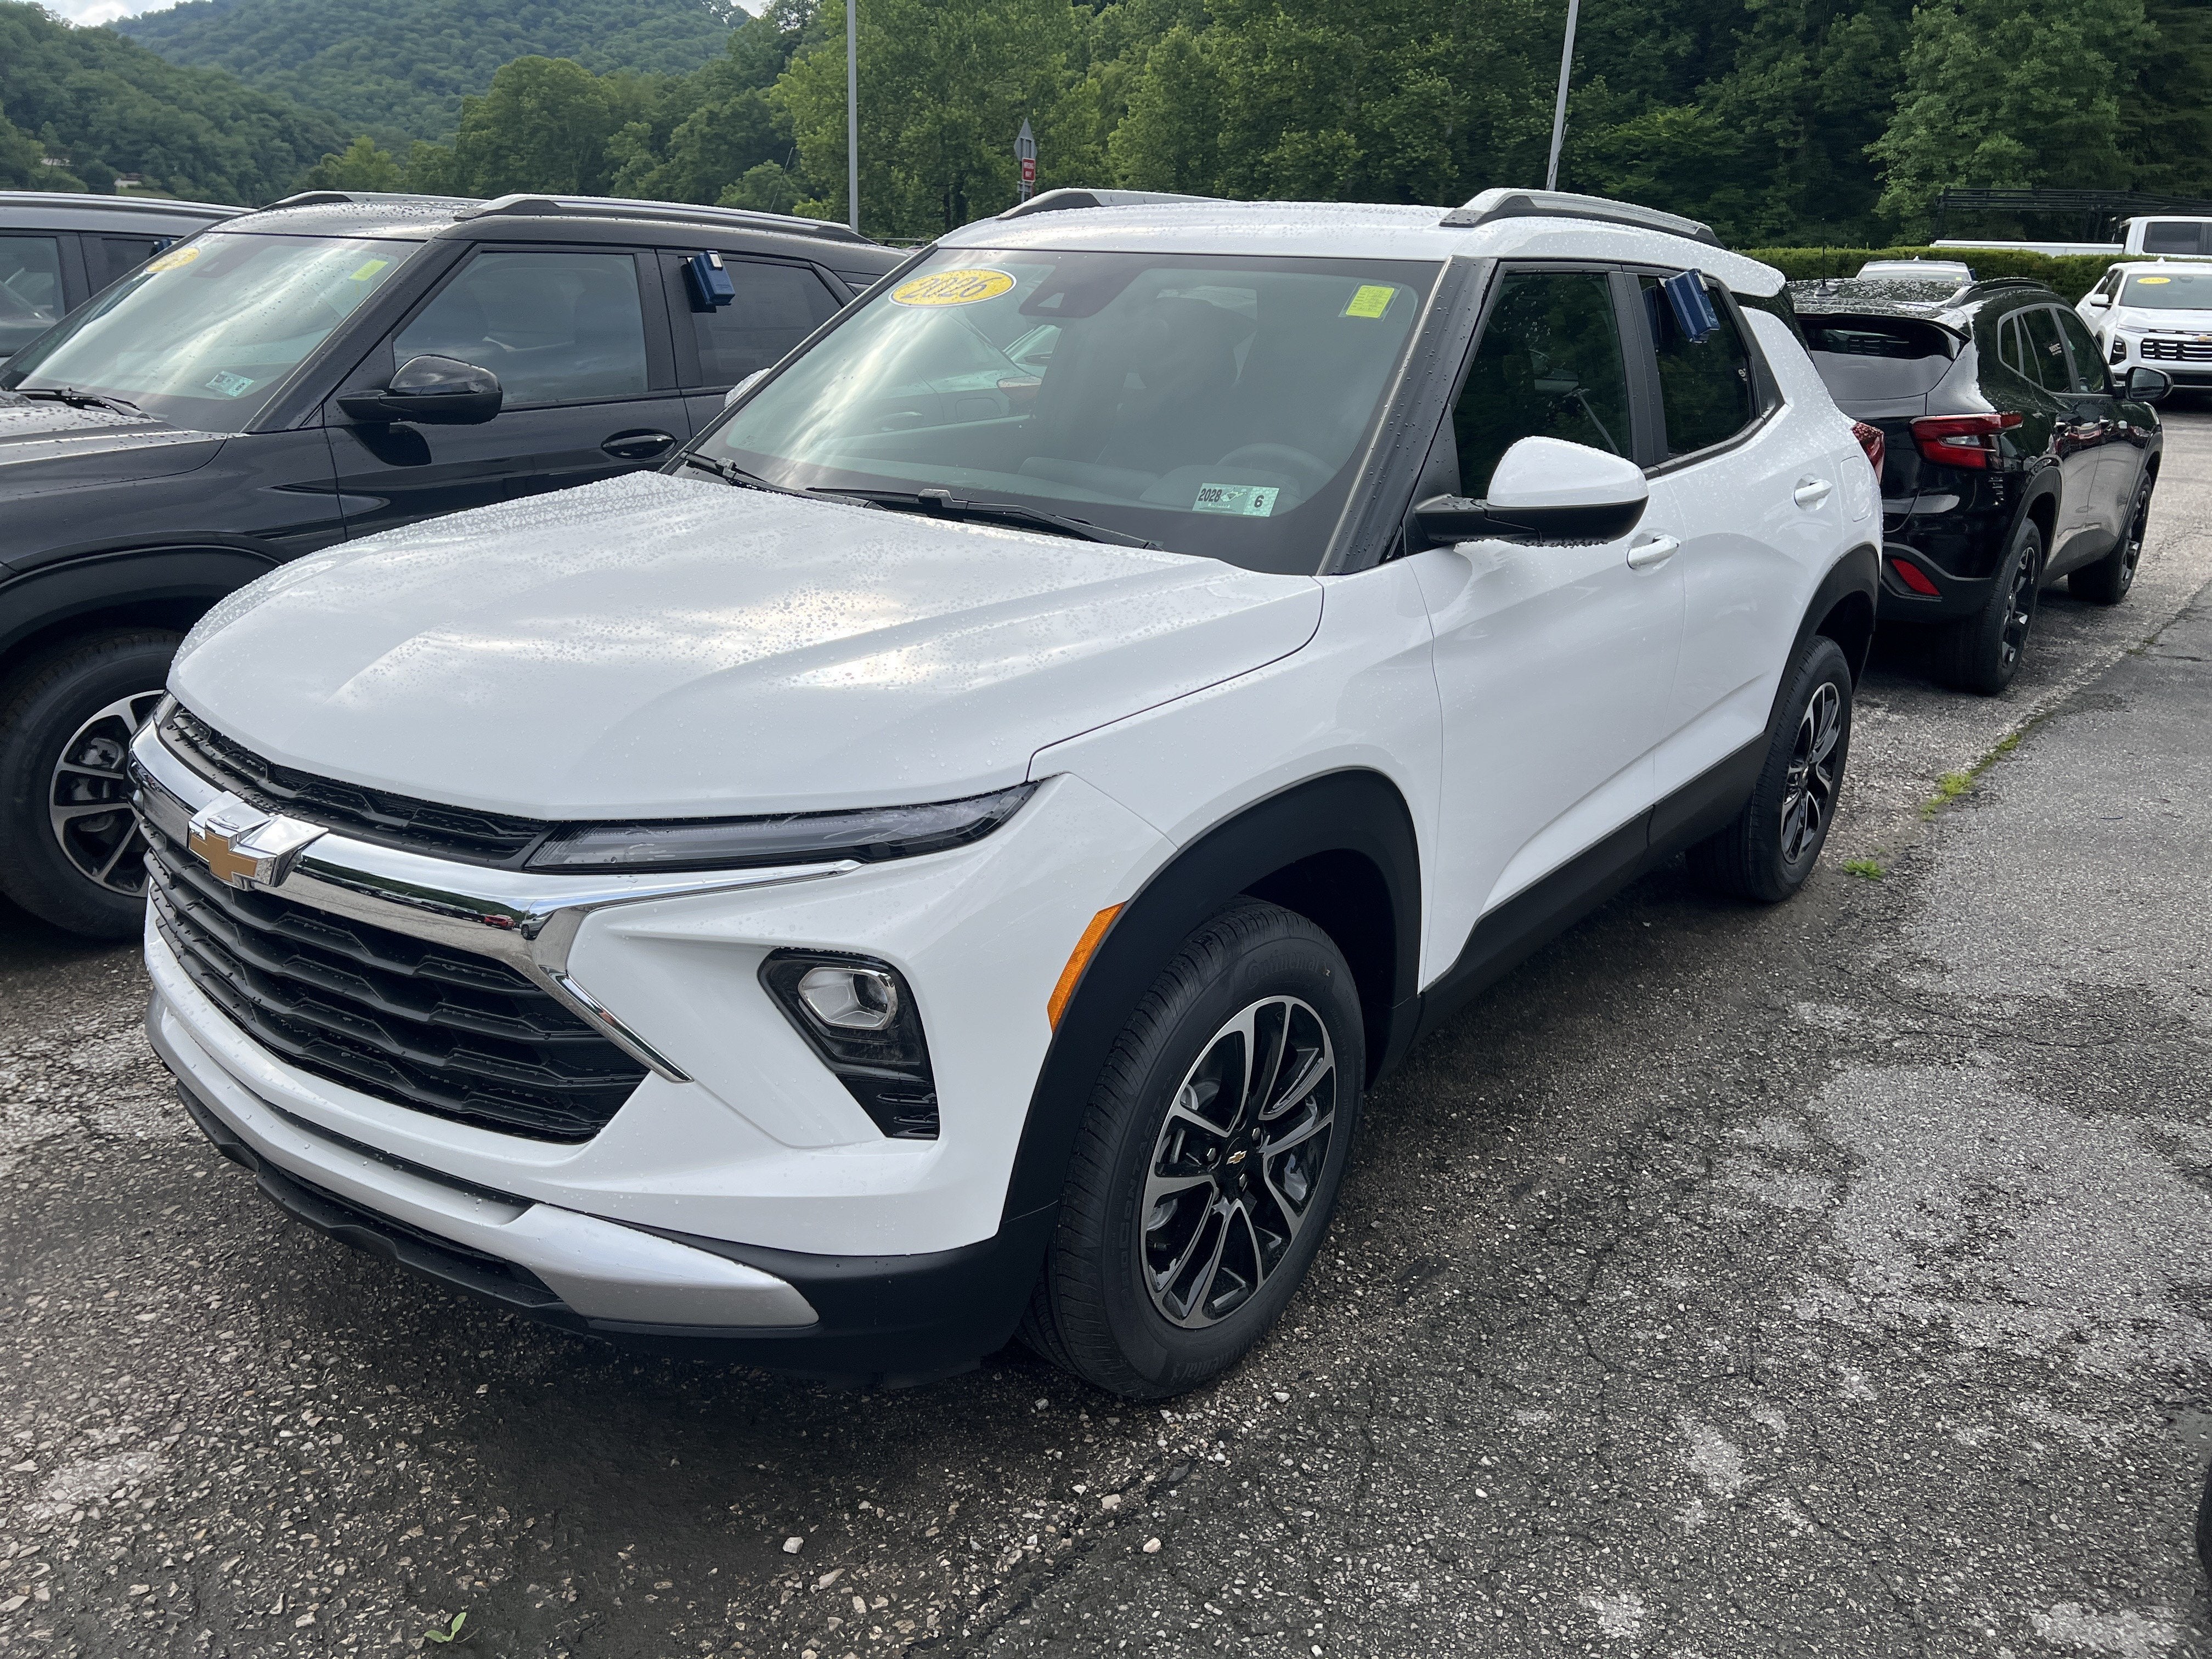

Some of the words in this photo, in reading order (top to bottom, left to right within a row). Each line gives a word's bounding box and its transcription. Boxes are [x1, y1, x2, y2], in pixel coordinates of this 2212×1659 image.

[900, 276, 1002, 298] 2026
[1198, 488, 1222, 503] 2028
[1254, 495, 1265, 508] 6
[1244, 949, 1320, 991] Continental
